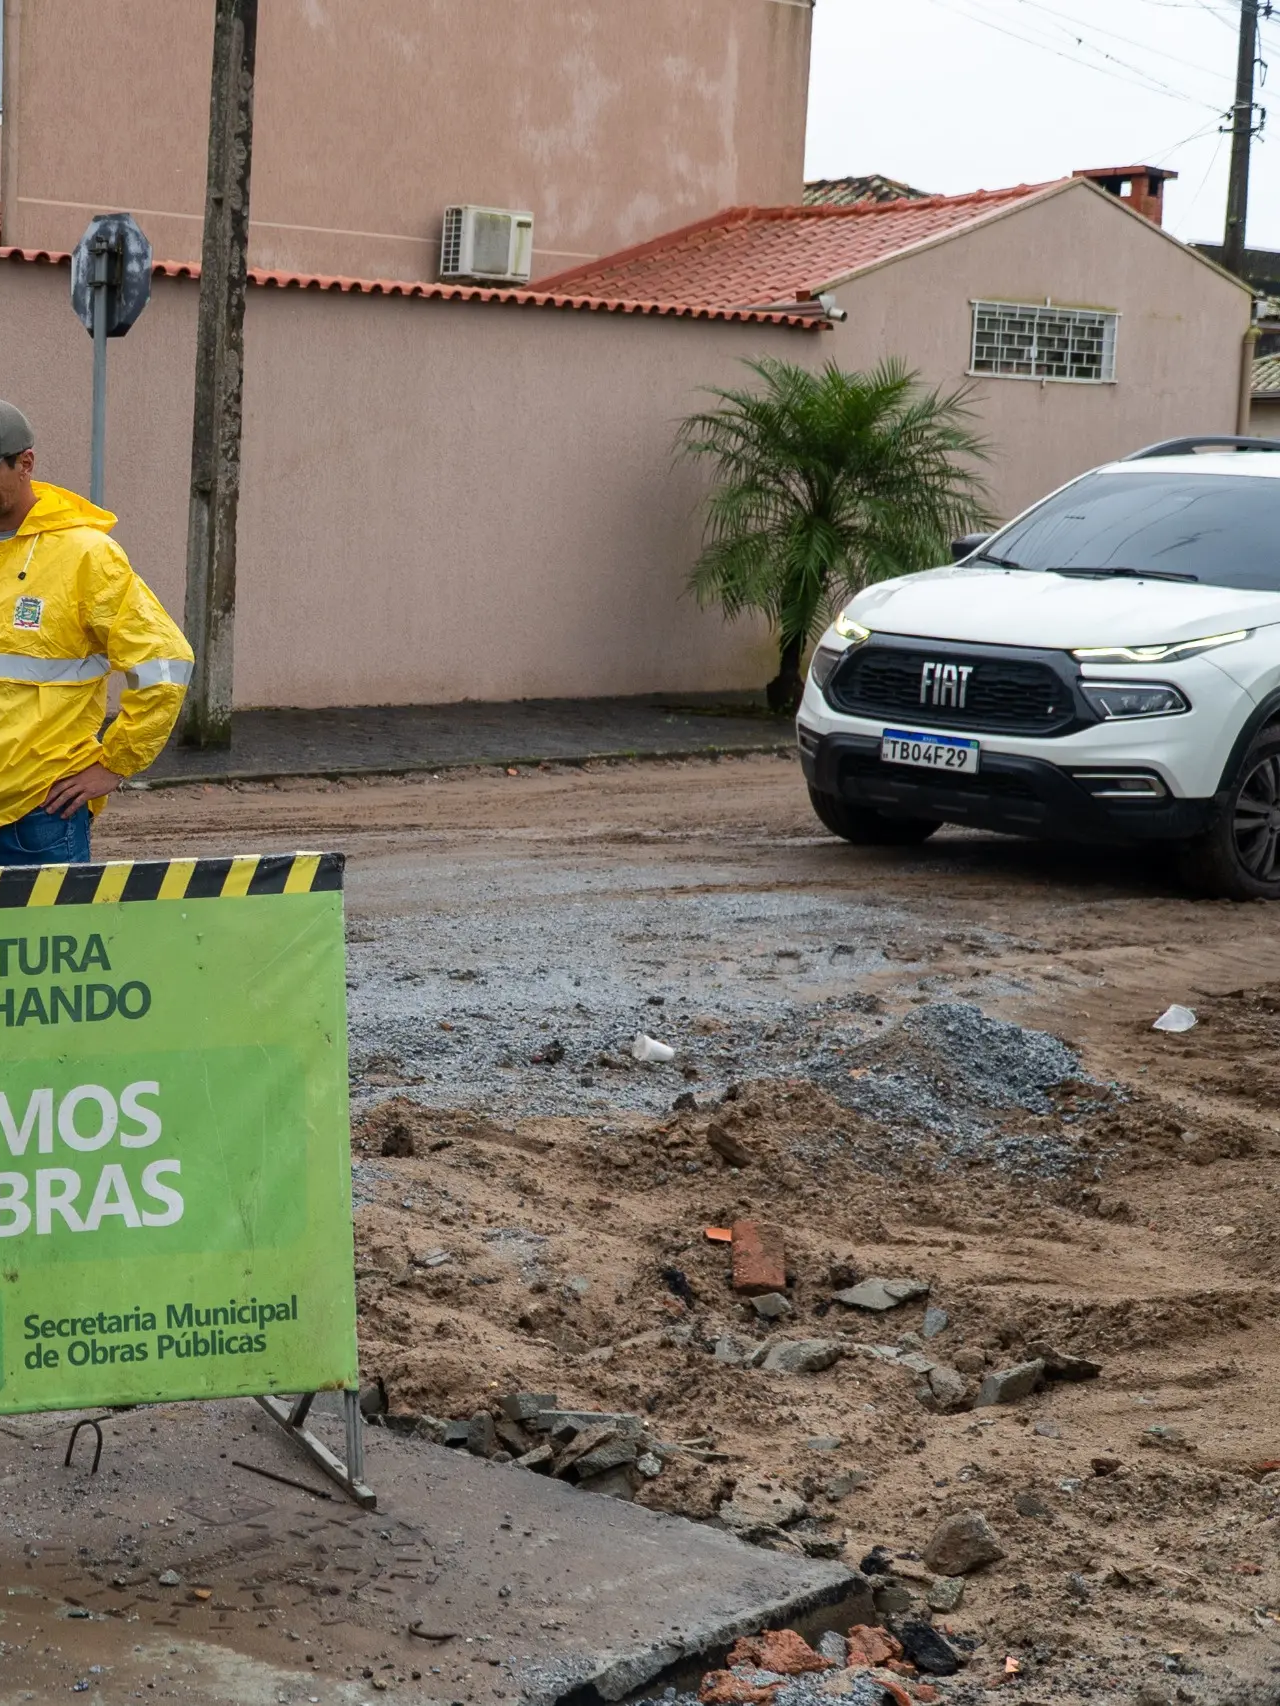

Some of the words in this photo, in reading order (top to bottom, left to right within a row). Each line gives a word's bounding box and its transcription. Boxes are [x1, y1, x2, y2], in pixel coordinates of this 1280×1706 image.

[920, 662, 973, 708] FIAT
[24, 1306, 157, 1340] Secretaria
[166, 1294, 298, 1330] Municipal
[24, 1342, 59, 1370] de
[67, 1339, 149, 1366] Obras
[157, 1329, 267, 1360] Públicas
